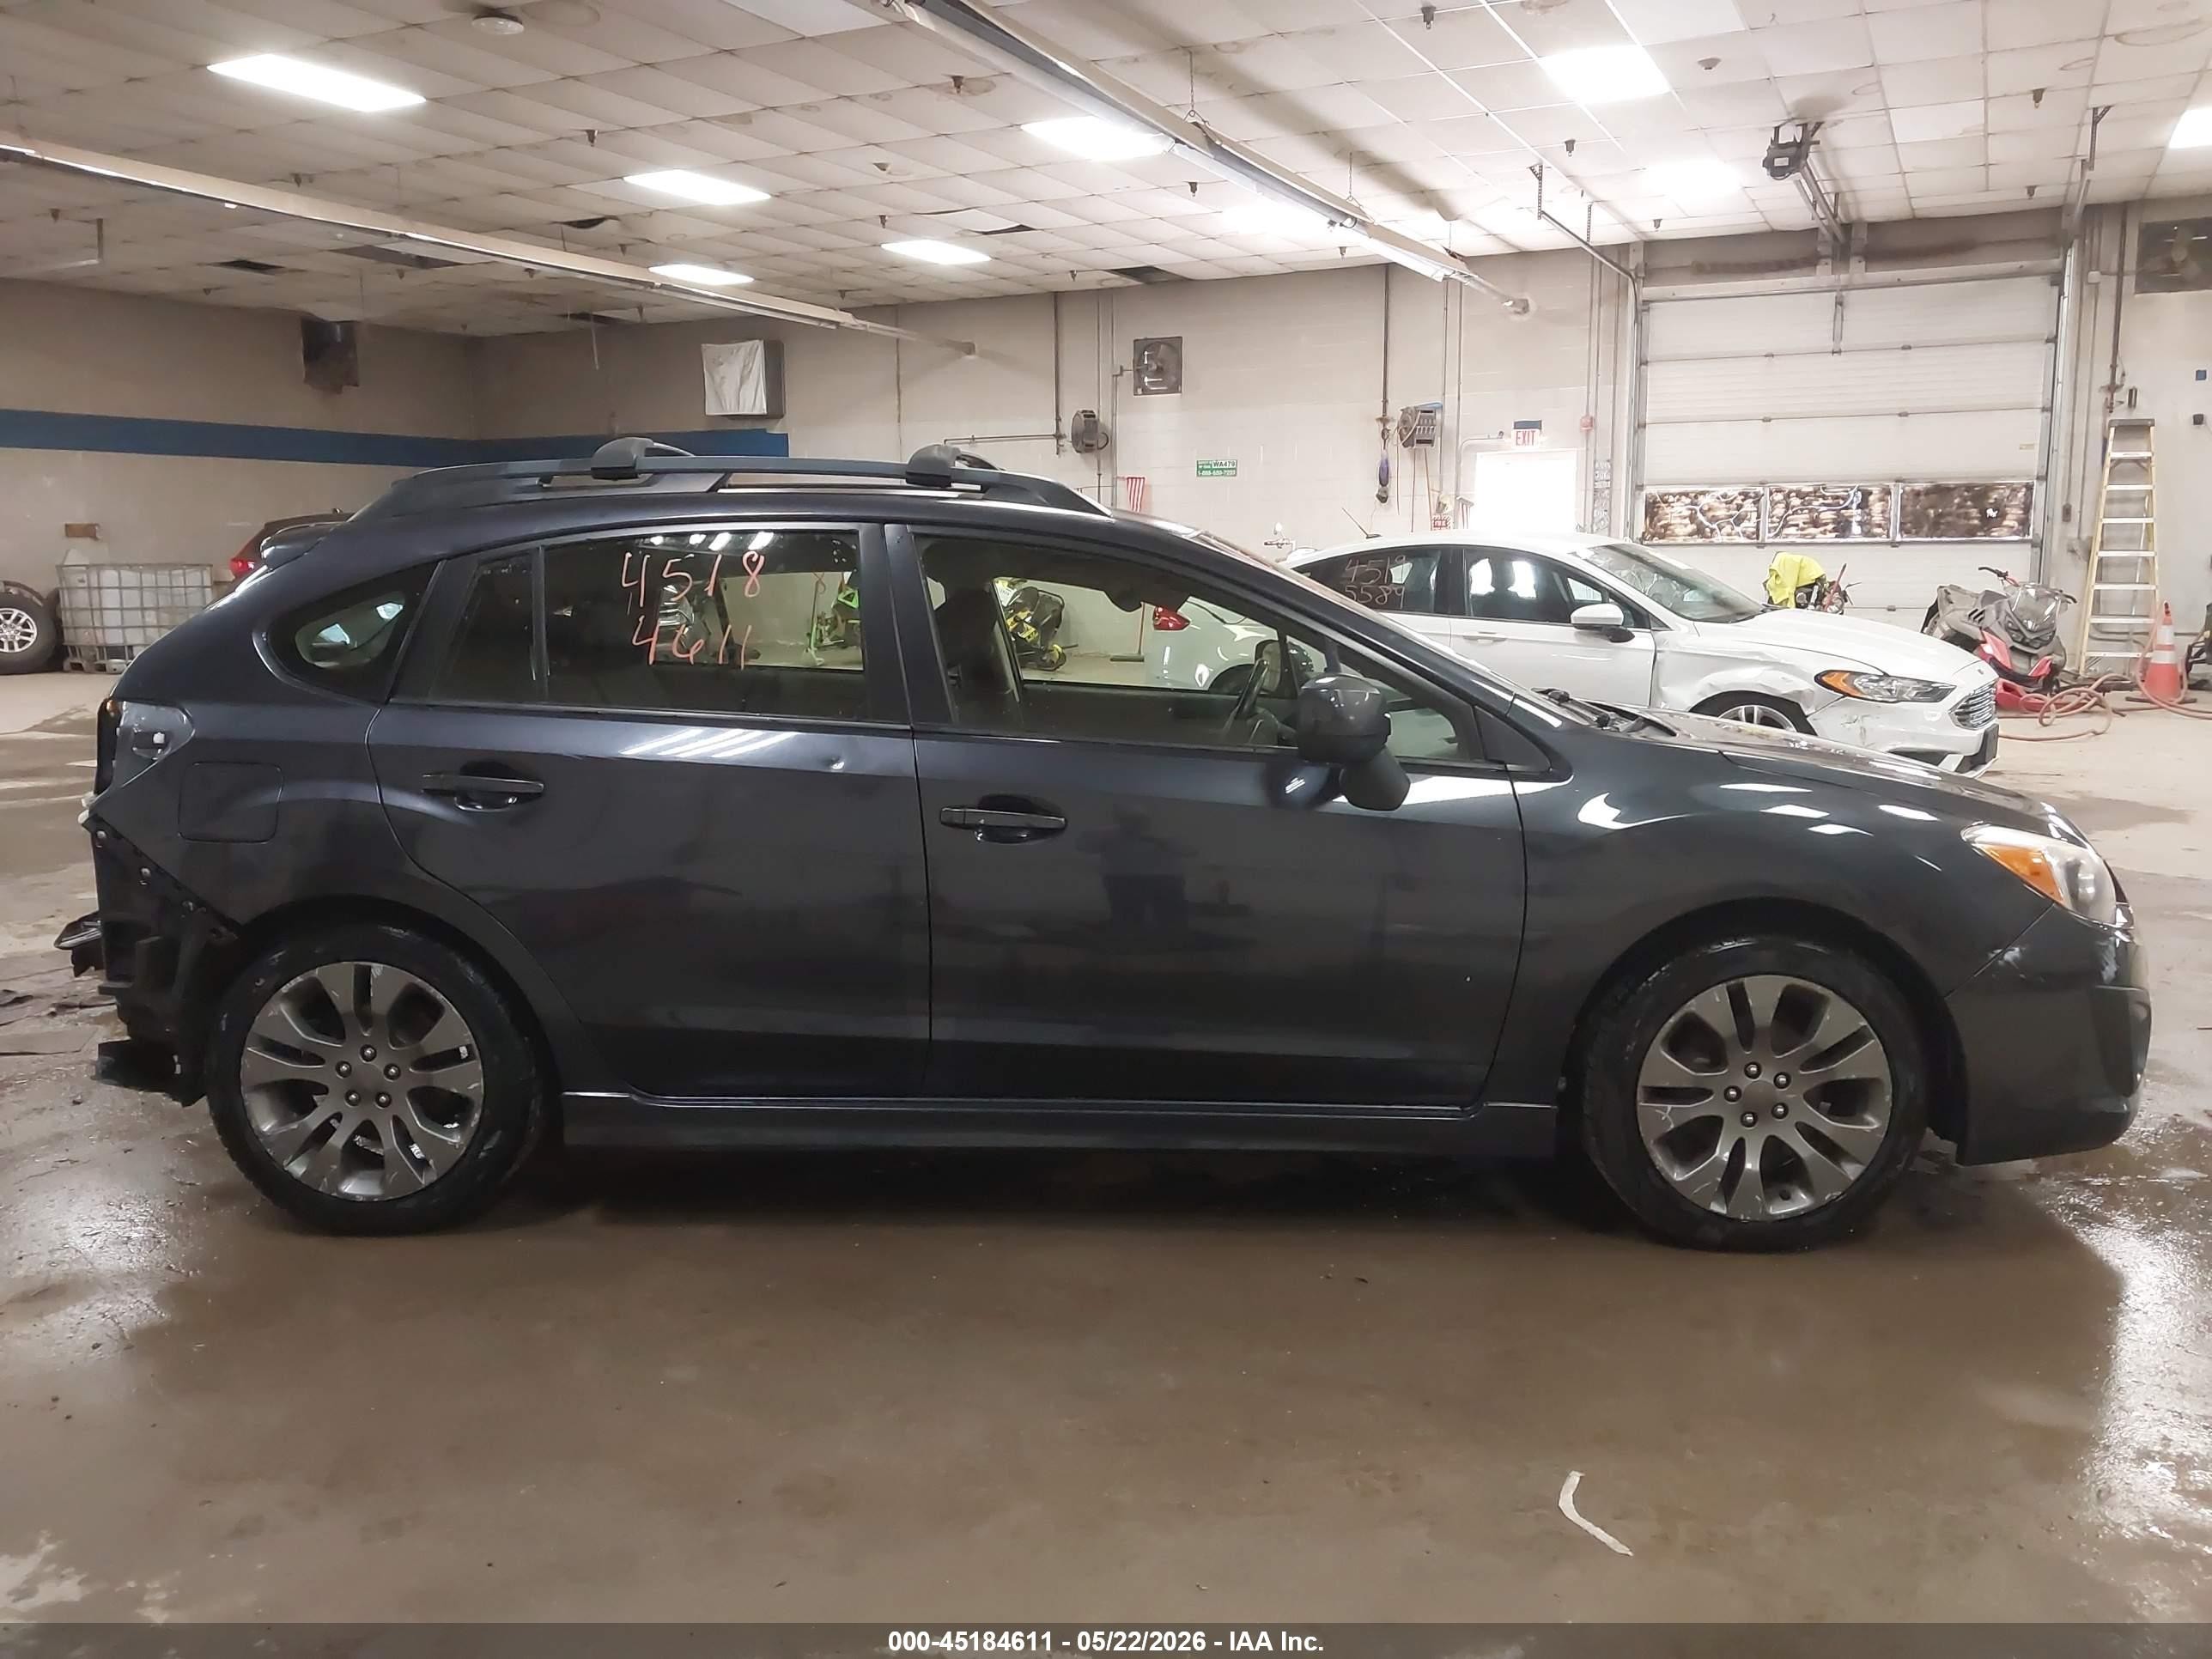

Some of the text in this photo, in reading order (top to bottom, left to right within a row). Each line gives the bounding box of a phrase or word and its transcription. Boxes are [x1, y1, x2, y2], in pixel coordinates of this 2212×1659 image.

[1516, 430, 1536, 446] EXIT
[621, 550, 765, 607] 4518
[1345, 555, 1407, 586] 4519
[1345, 585, 1405, 610] 5589
[632, 615, 751, 670] 4611
